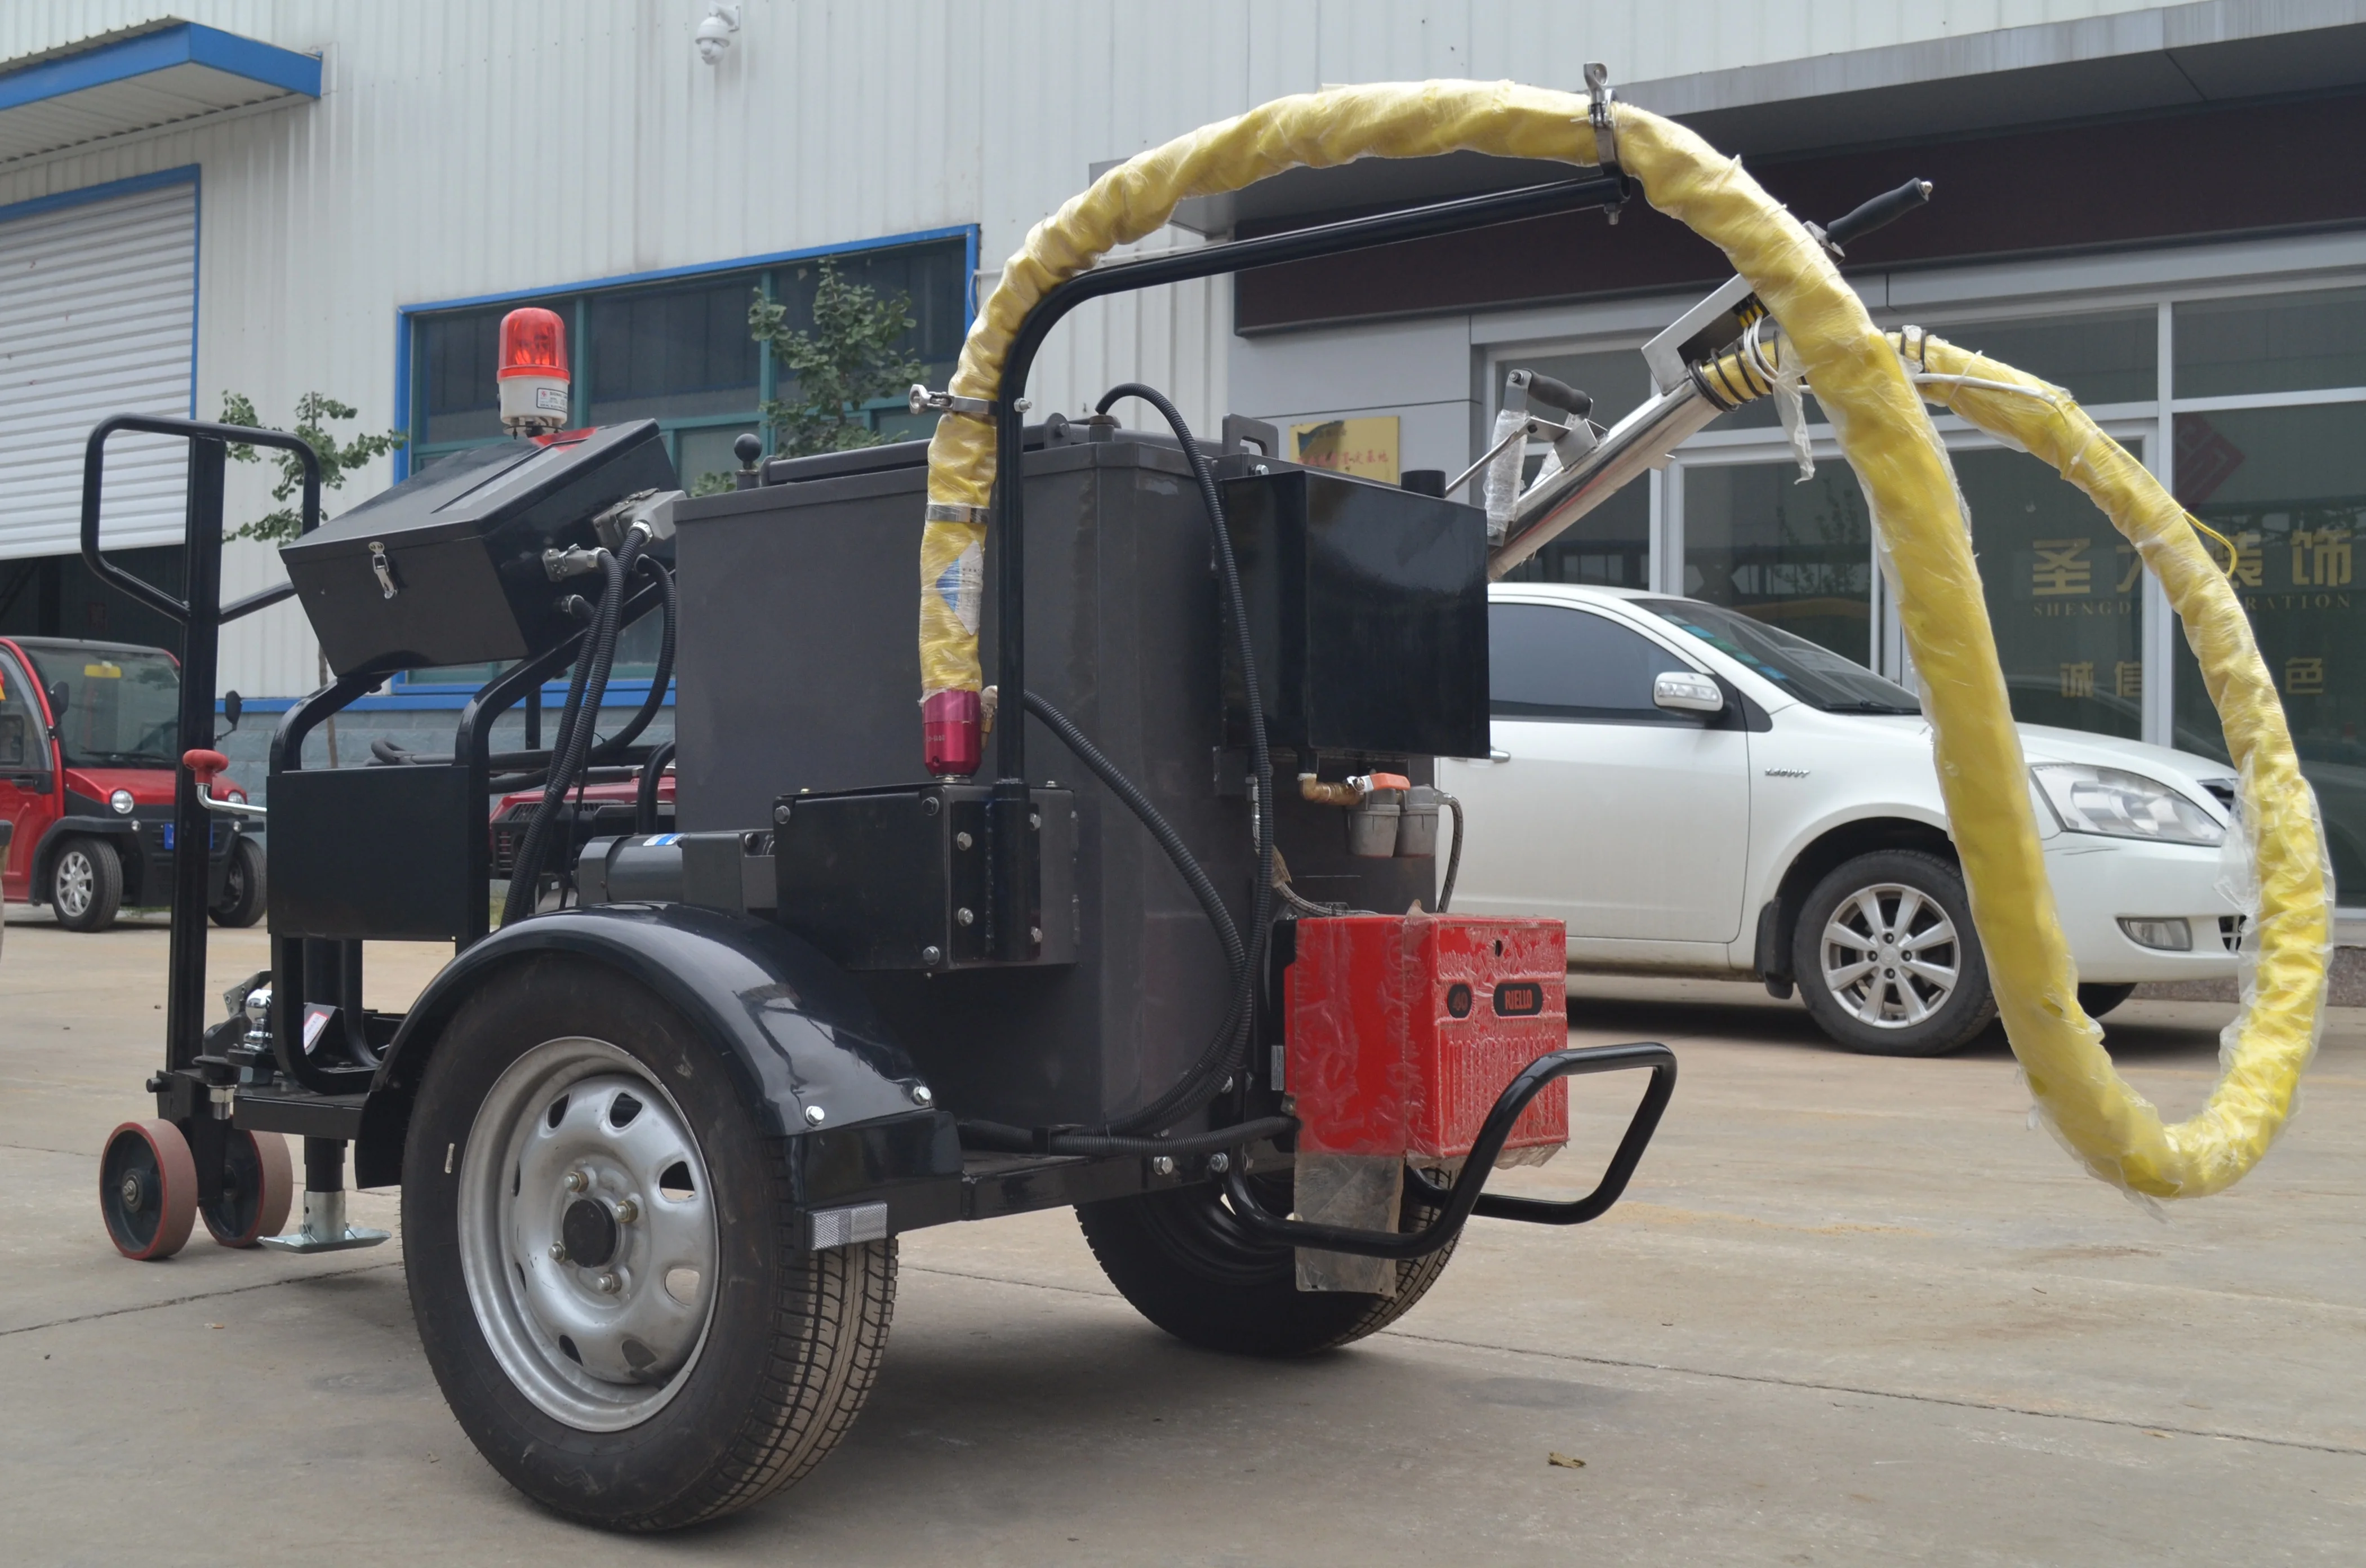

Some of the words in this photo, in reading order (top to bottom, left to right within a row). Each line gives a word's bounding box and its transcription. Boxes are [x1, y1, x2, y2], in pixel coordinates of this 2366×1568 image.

[2033, 599, 2142, 617] SHENGD
[2245, 594, 2351, 611] RATION
[1505, 989, 1533, 1010] RIELLO
